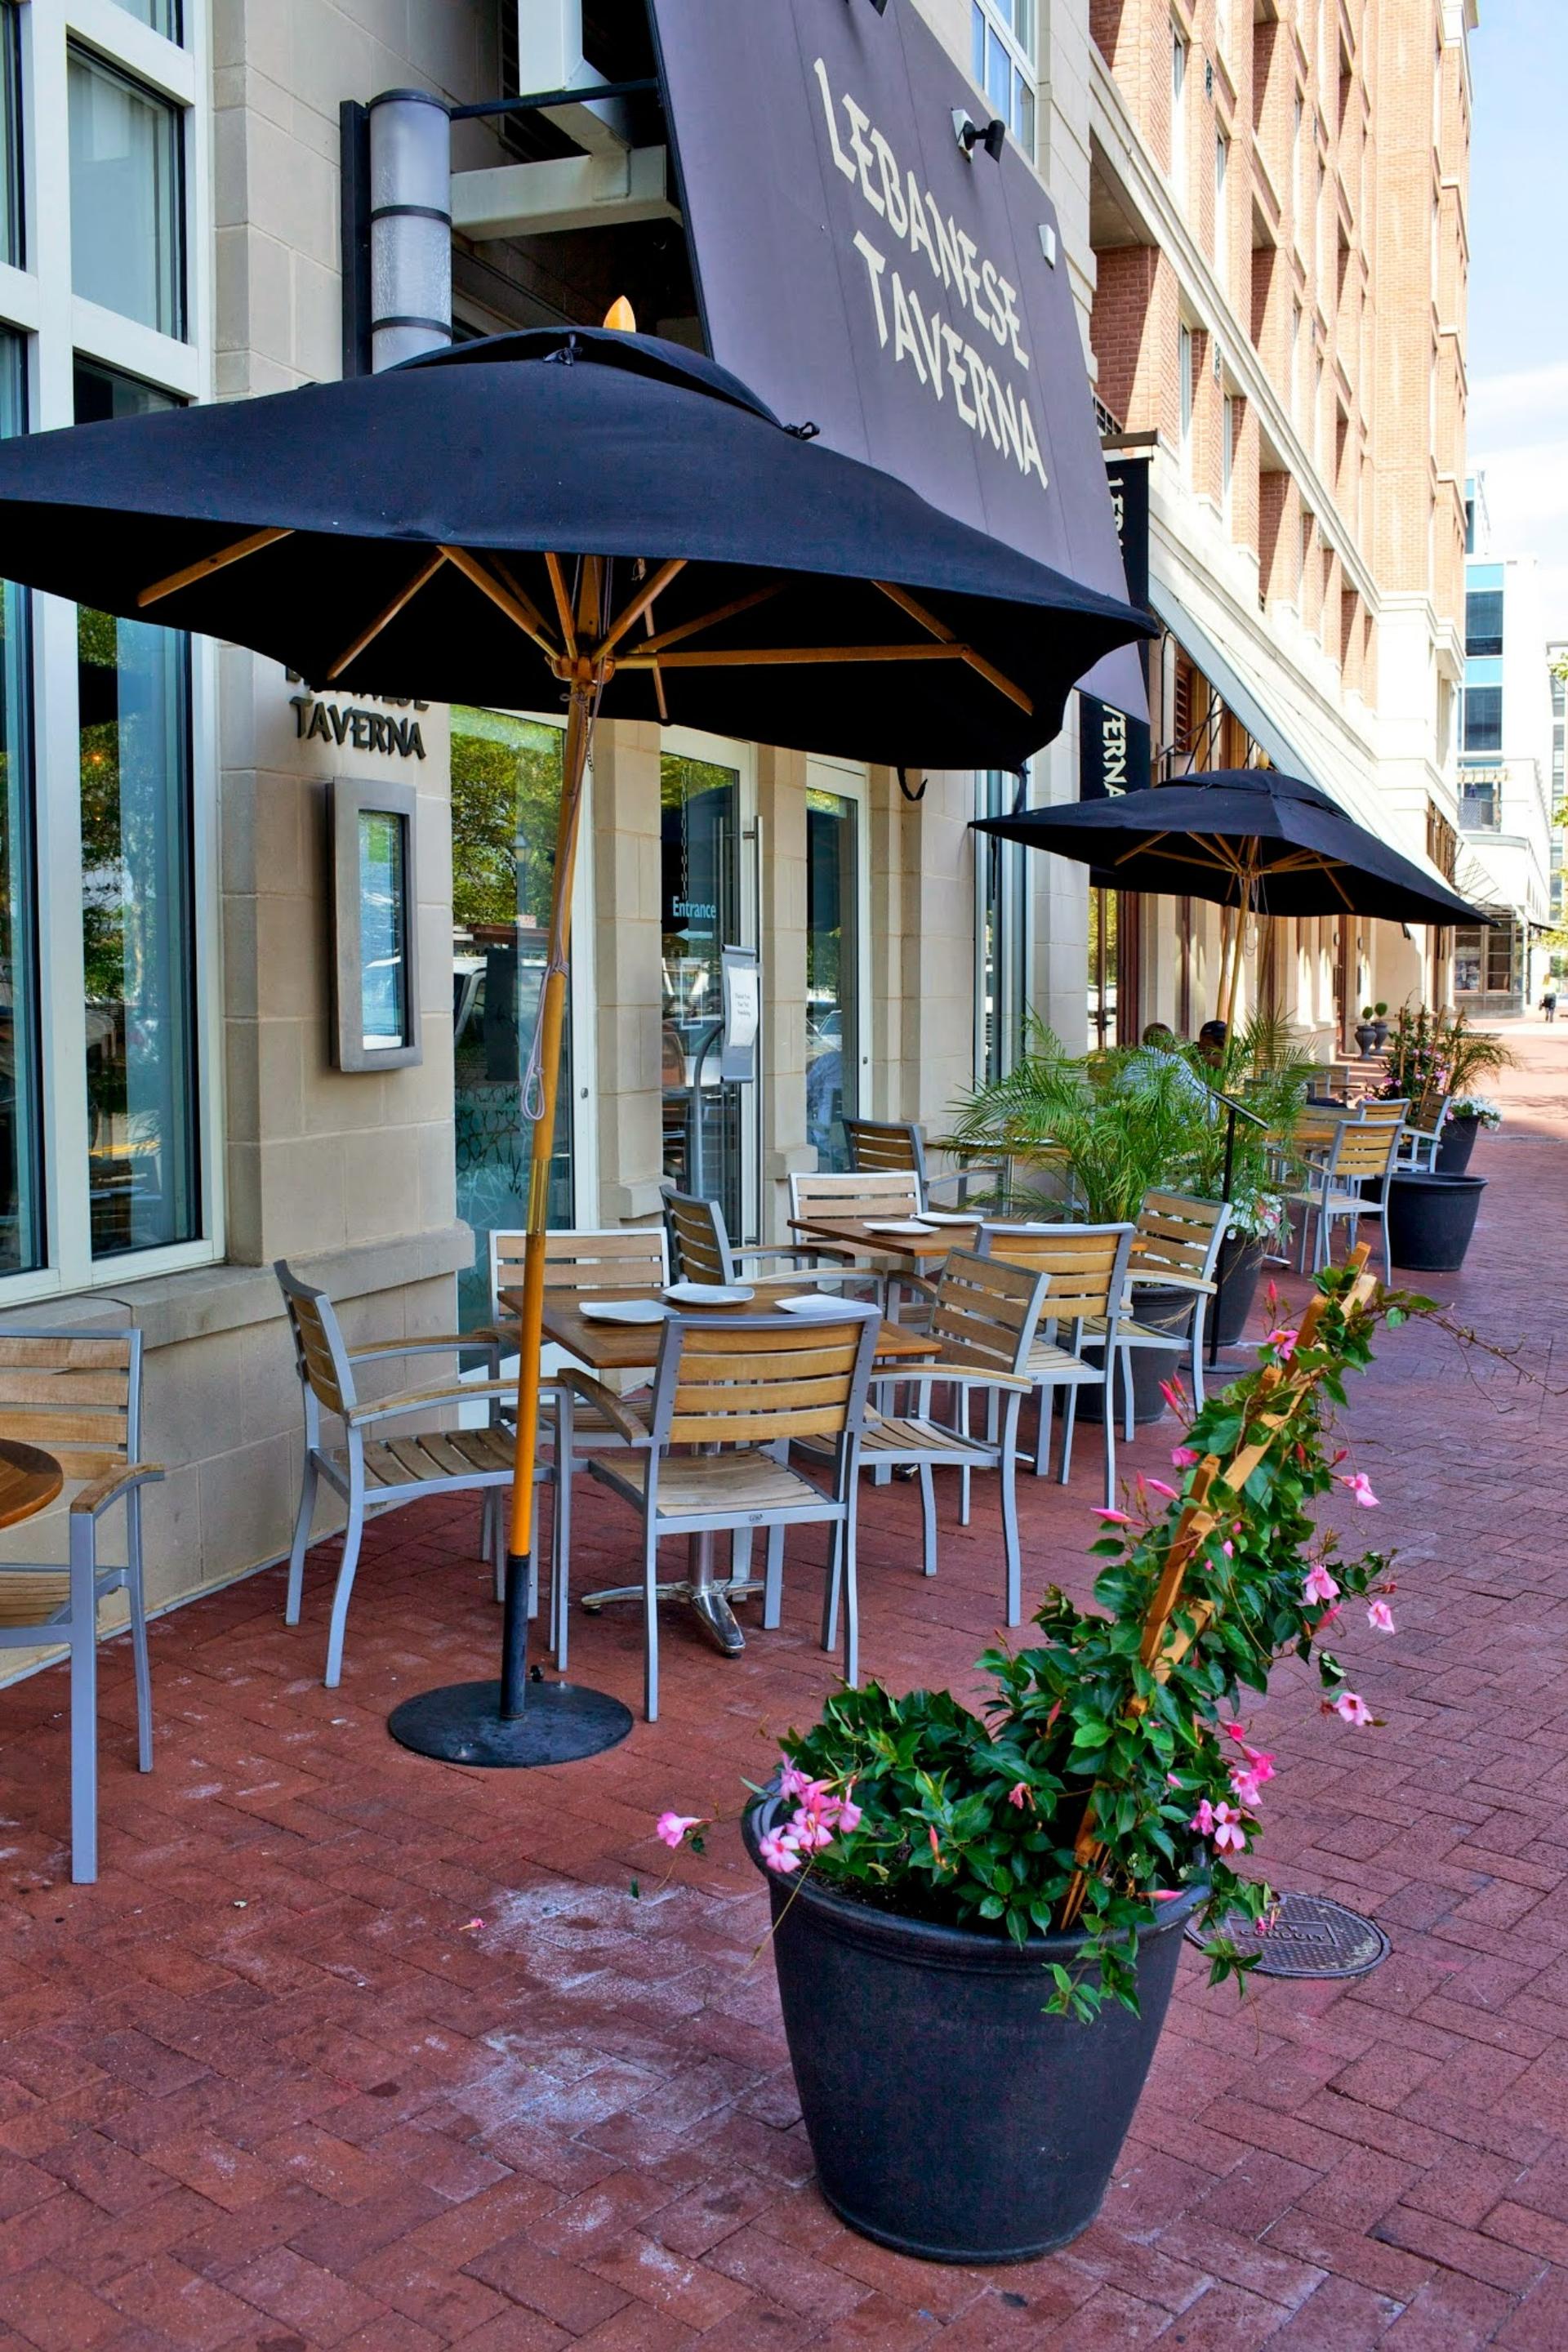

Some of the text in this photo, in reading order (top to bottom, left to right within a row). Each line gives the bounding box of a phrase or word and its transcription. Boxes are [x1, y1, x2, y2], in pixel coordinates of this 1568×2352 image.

[813, 57, 1029, 370] LEBANESE
[853, 230, 1048, 489] TAVERNA
[290, 696, 426, 760] TAVERNA
[673, 896, 716, 919] Entrance
[1240, 1928, 1325, 1940] CONDUIT
